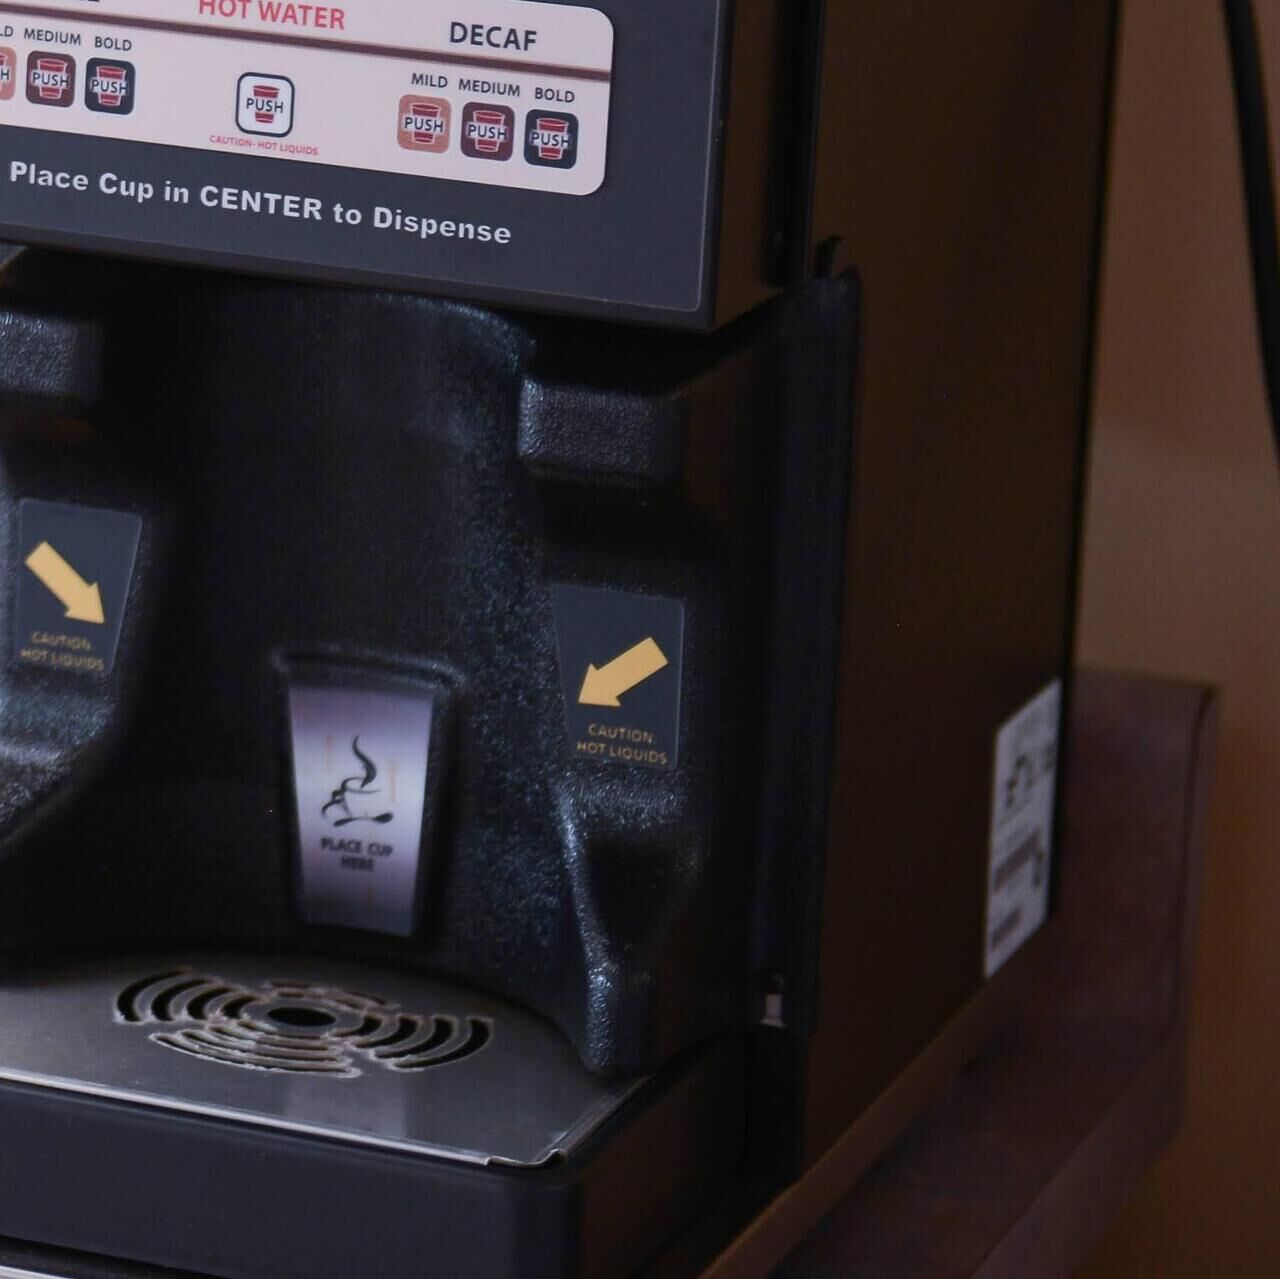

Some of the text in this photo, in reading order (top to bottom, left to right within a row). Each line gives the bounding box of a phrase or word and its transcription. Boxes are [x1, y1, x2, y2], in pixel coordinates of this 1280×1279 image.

[258, 0, 345, 30] WATER
[23, 28, 81, 46] MEDIUM
[94, 36, 132, 51] BOLD
[449, 22, 537, 51] DECAF
[32, 72, 69, 87] PUSH
[91, 79, 128, 95] PUSH
[411, 73, 575, 103] MILD MEDIUM BOLD
[246, 98, 284, 113] PUSH
[404, 116, 444, 132] PUSH
[467, 124, 507, 140] PUSH
[531, 131, 570, 147] PUSH
[258, 141, 278, 150] HOT
[279, 144, 319, 155] LIQUIDS
[9, 161, 511, 244] Place Cup in CENTER to Dispense
[588, 724, 653, 744] CAUTION
[576, 741, 667, 765] HOT LIQUIDS
[320, 837, 362, 854] PLACE
